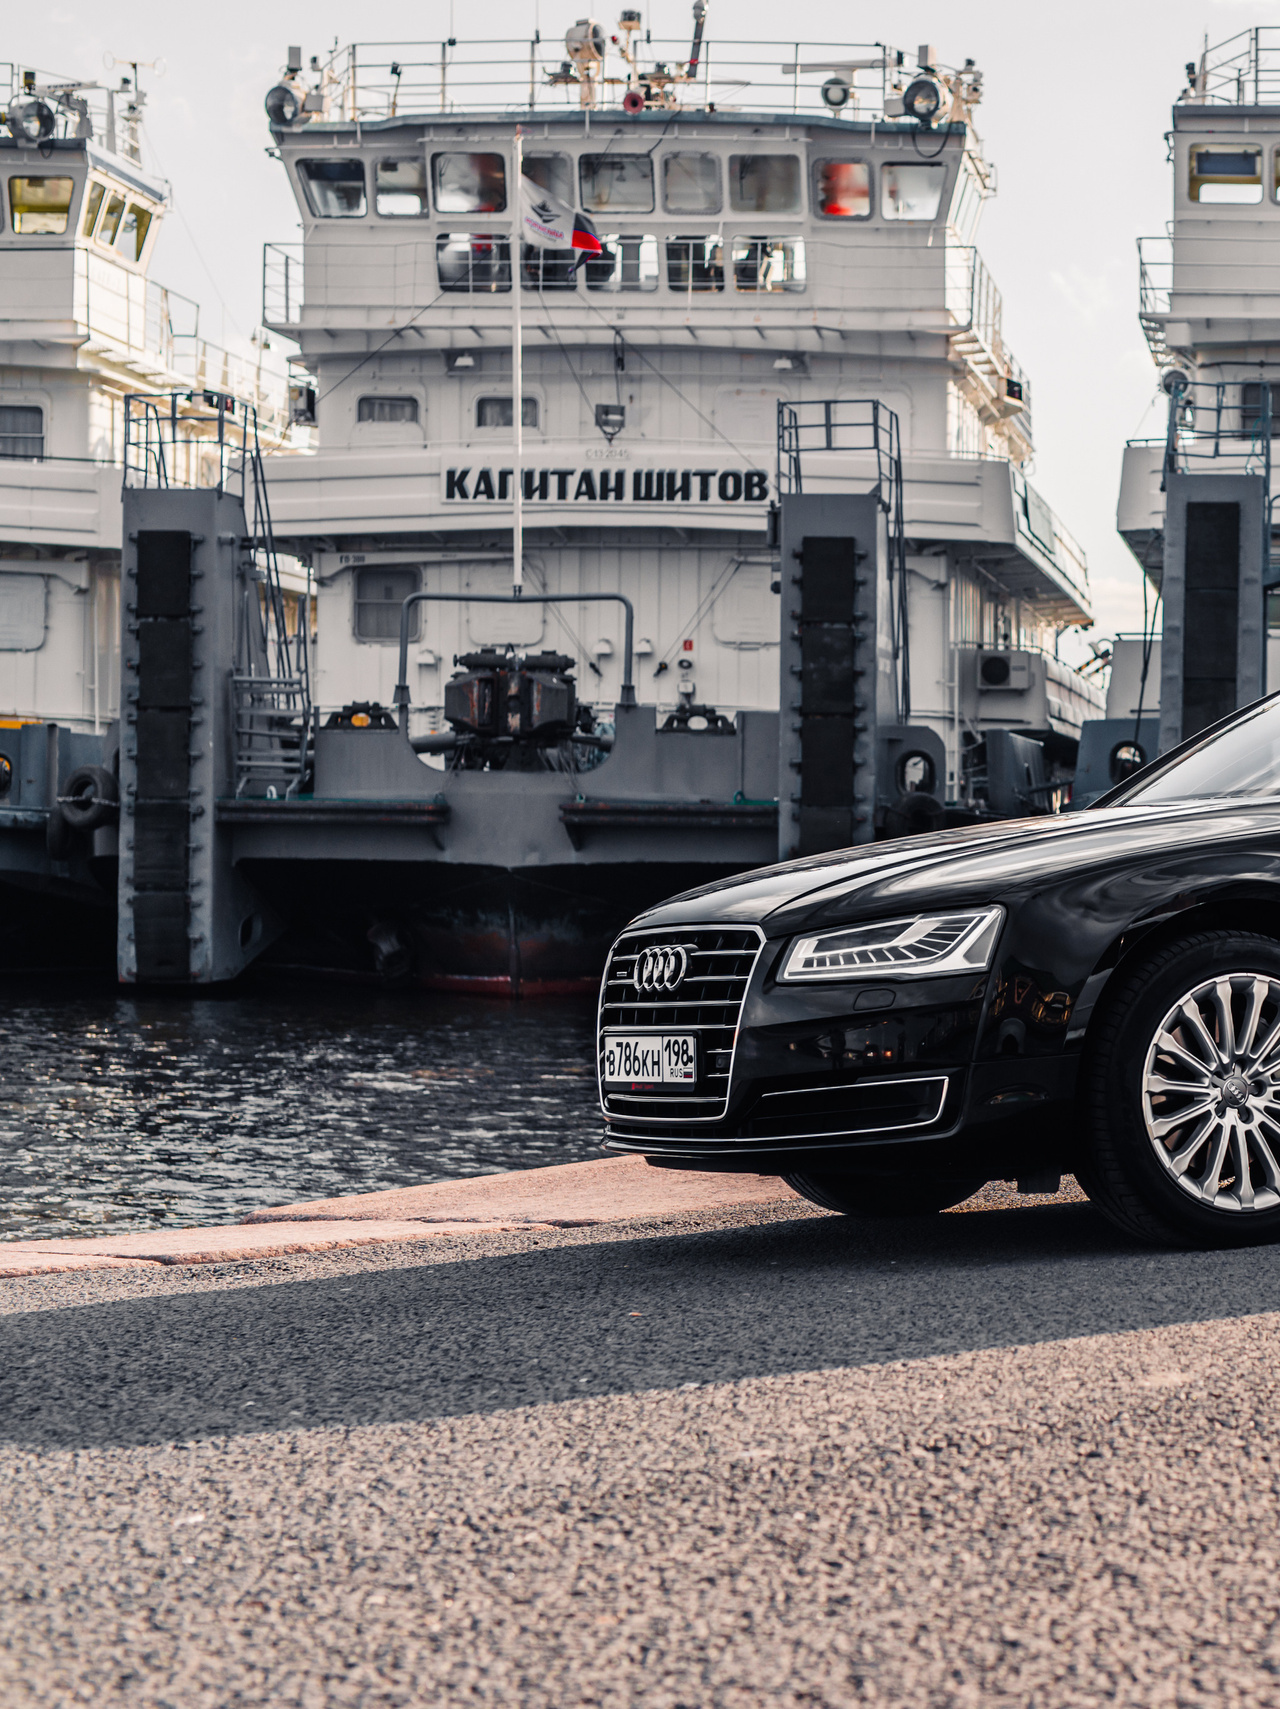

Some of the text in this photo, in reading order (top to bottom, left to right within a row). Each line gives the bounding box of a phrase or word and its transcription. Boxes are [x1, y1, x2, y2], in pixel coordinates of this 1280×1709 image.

[633, 469, 770, 502] ШИТОВ
[664, 1039, 689, 1067] 198
[670, 1068, 684, 1078] RUS
